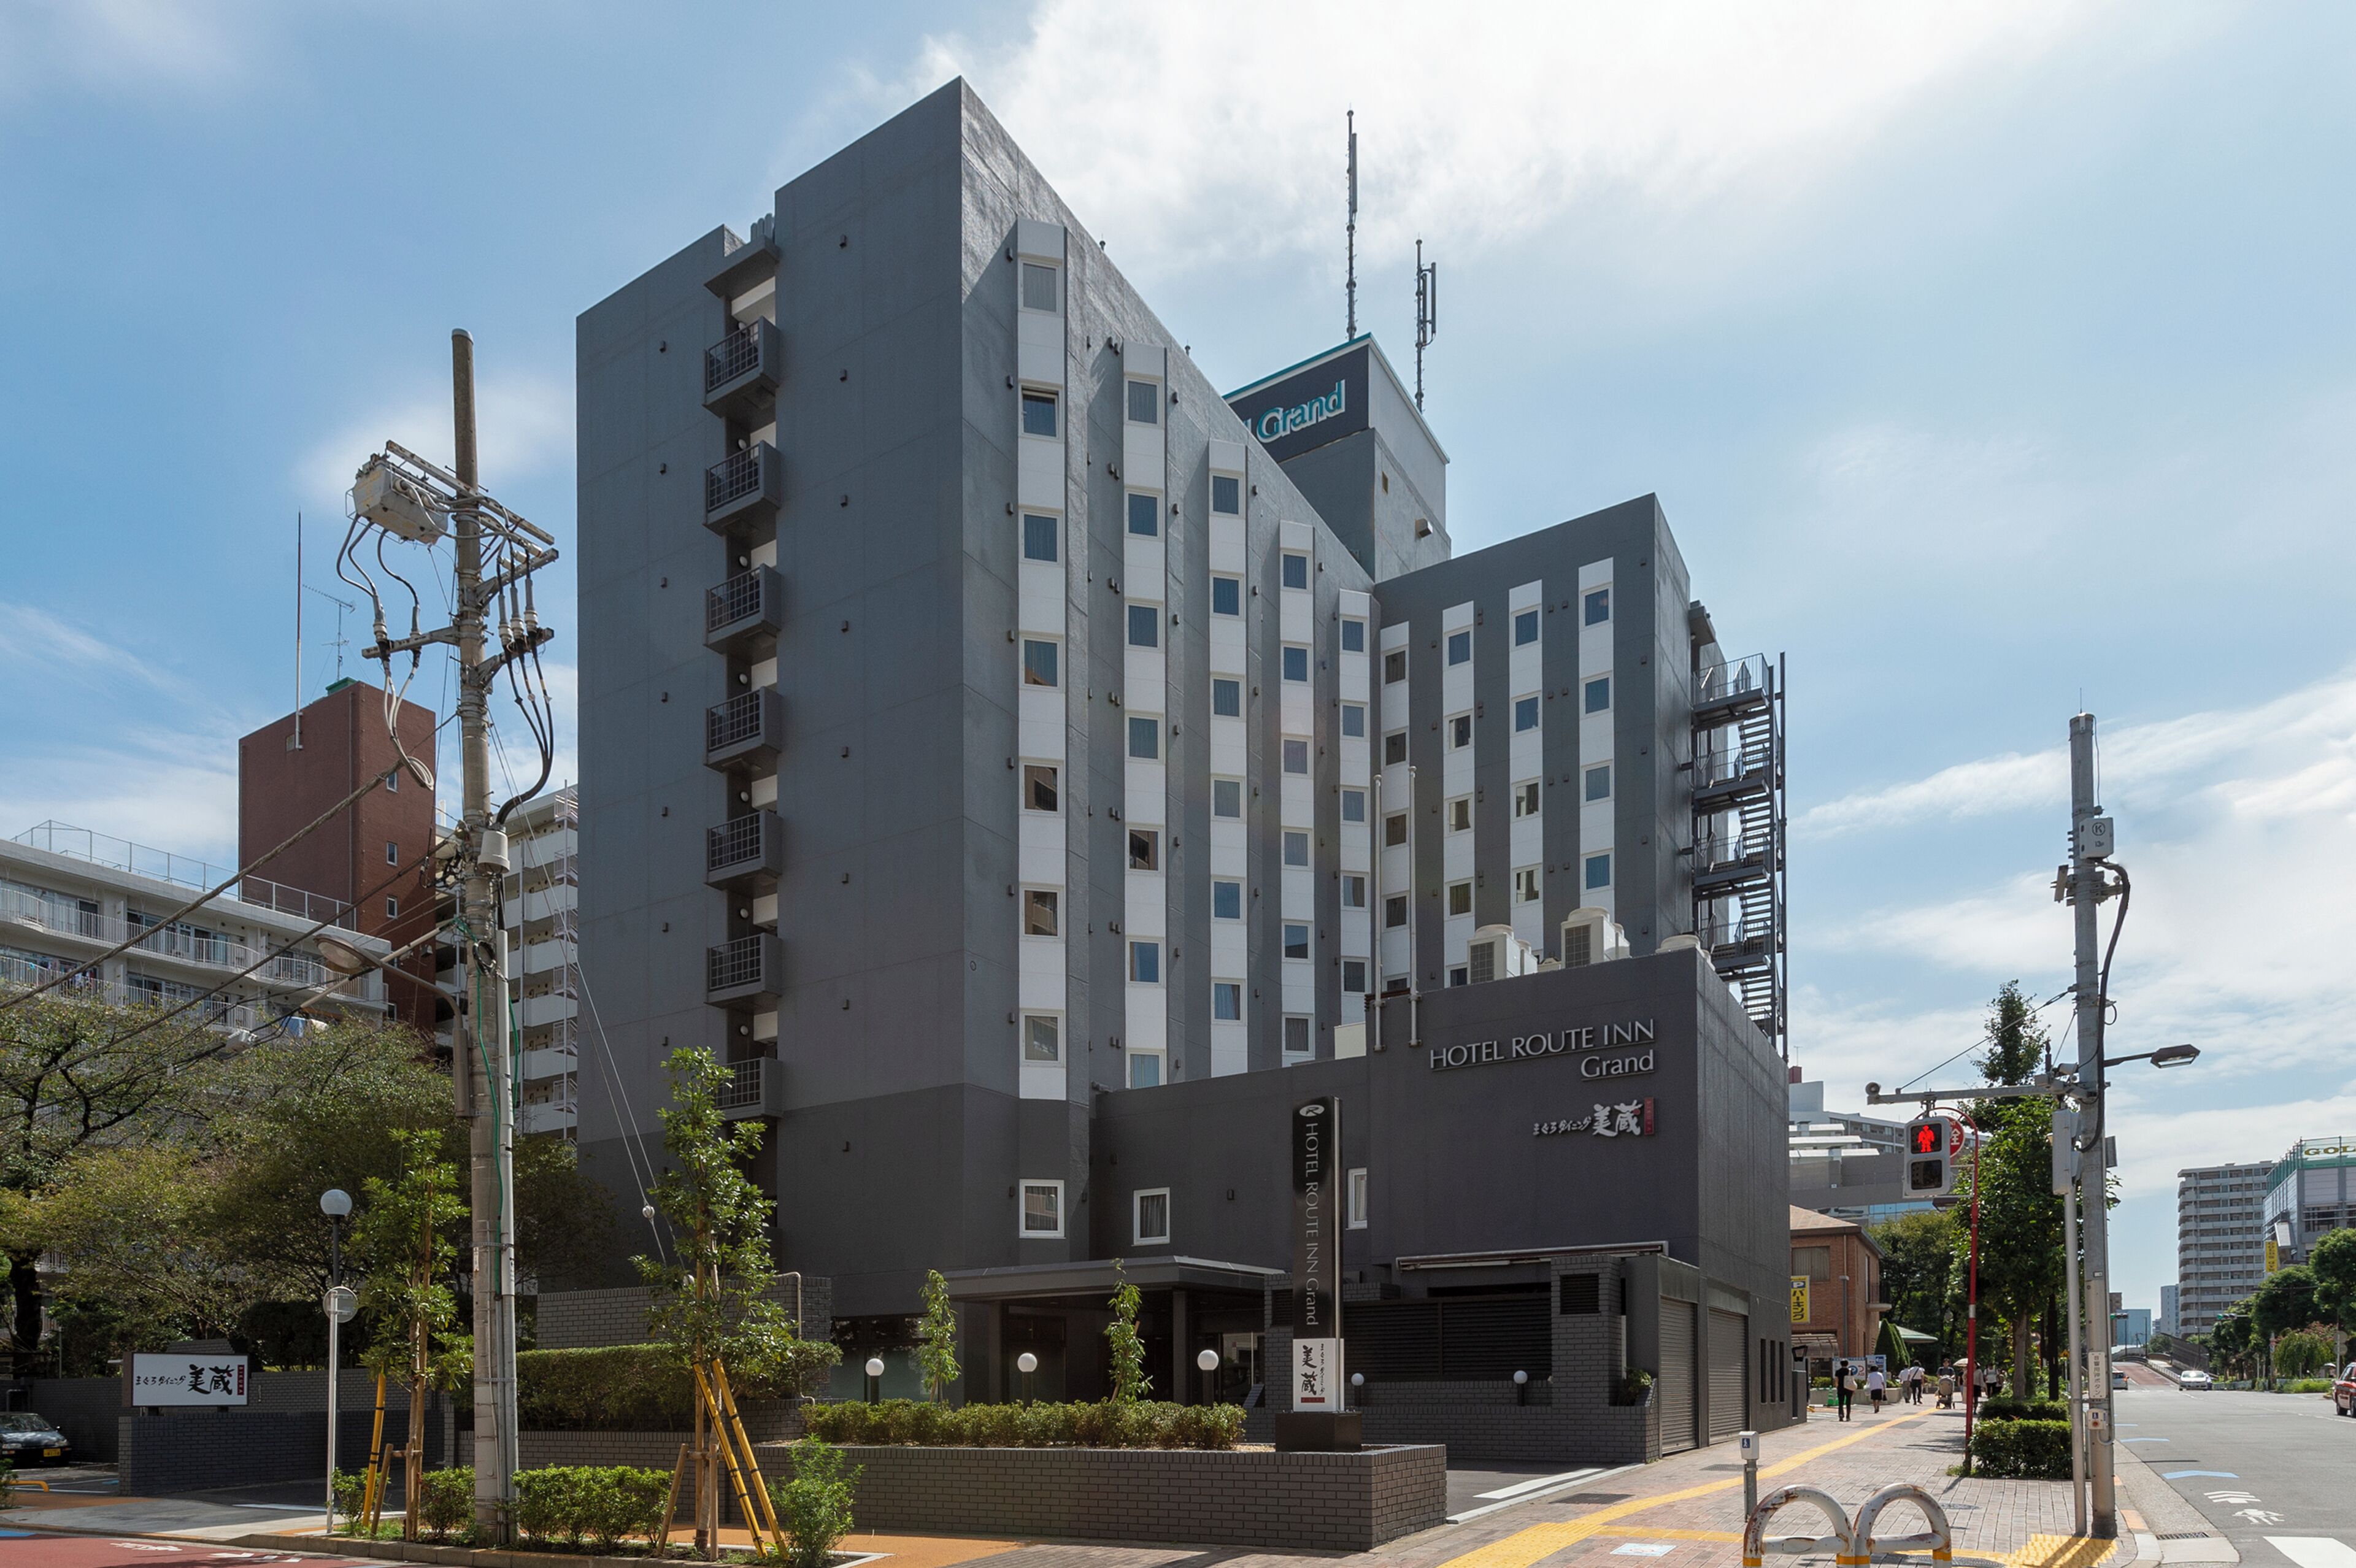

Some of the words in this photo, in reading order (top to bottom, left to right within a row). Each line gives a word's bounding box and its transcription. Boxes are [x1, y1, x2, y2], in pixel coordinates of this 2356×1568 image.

[1257, 379, 1345, 443] Grand
[1430, 1040, 1504, 1069] HOTEL
[1512, 1026, 1593, 1058] ROUTE
[1604, 1018, 1654, 1045] INN
[1580, 1049, 1654, 1078] Grand
[1592, 1099, 1643, 1137] 美蔵
[1306, 1123, 1319, 1178] HOTEL
[1306, 1182, 1319, 1238] ROUTE
[1306, 1242, 1319, 1273] INN
[1306, 1278, 1319, 1325] Grand
[1793, 1289, 1804, 1321] パーキング
[135, 1375, 187, 1386] まぐろダイニング
[187, 1364, 235, 1396] 美蔵
[1301, 1345, 1317, 1396] 美蔵
